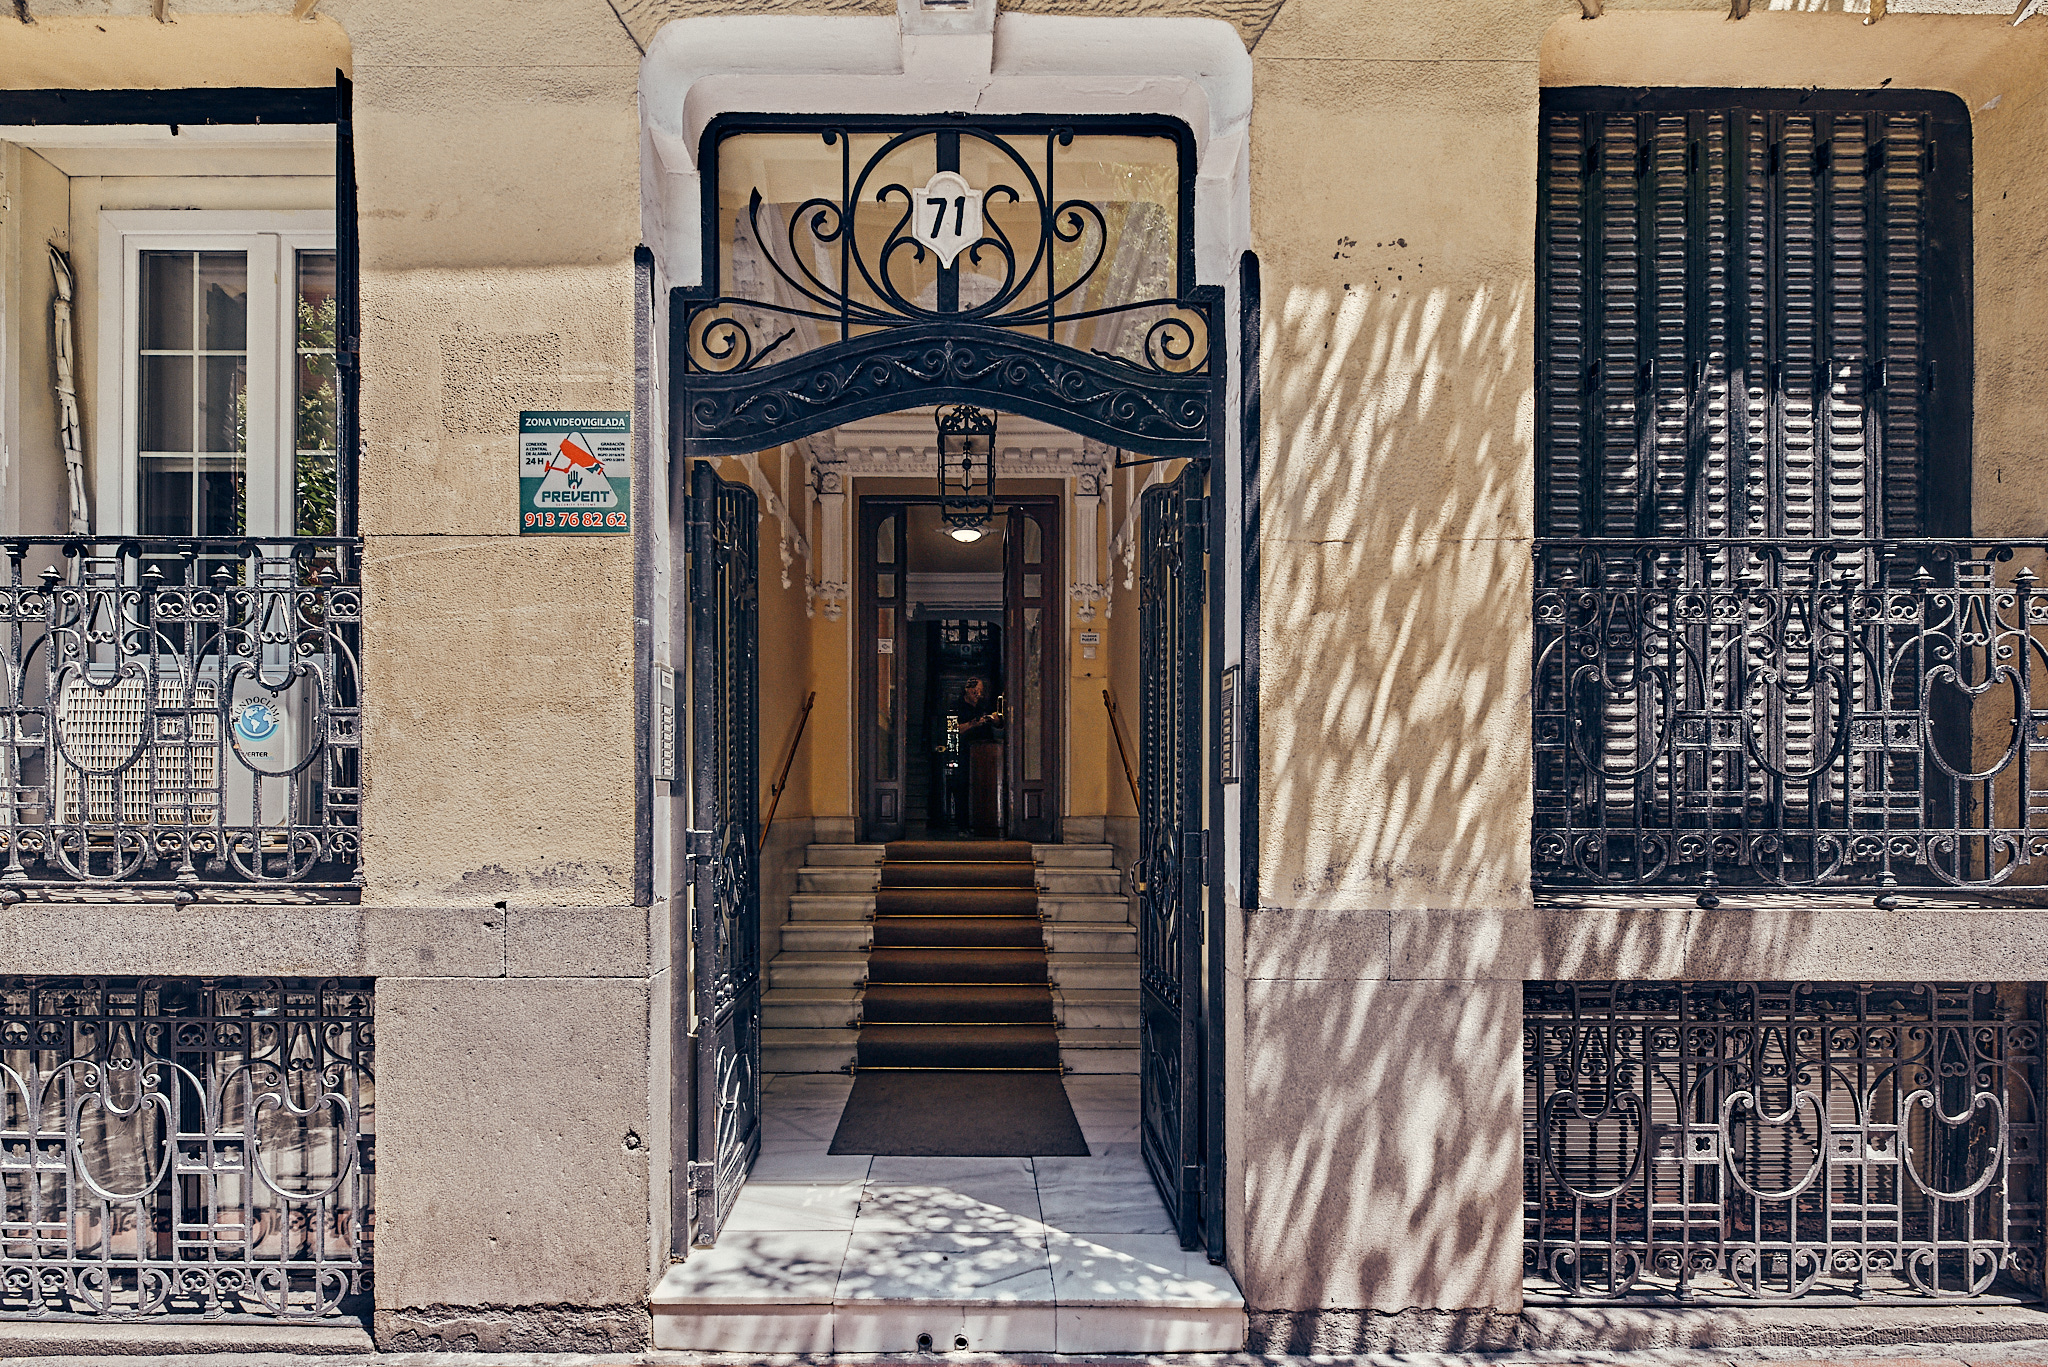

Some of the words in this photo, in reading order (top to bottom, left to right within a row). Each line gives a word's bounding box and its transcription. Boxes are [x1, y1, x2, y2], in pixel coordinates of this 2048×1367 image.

[926, 195, 966, 239] 71
[525, 418, 551, 426] ZONA
[553, 418, 625, 426] VIDEOVIGILADA
[525, 457, 536, 465] 24
[537, 457, 544, 465] H
[541, 491, 609, 502] PREVENT
[525, 512, 555, 527] 913
[559, 512, 580, 527] 76
[582, 512, 603, 527] 82
[606, 512, 627, 527] 62
